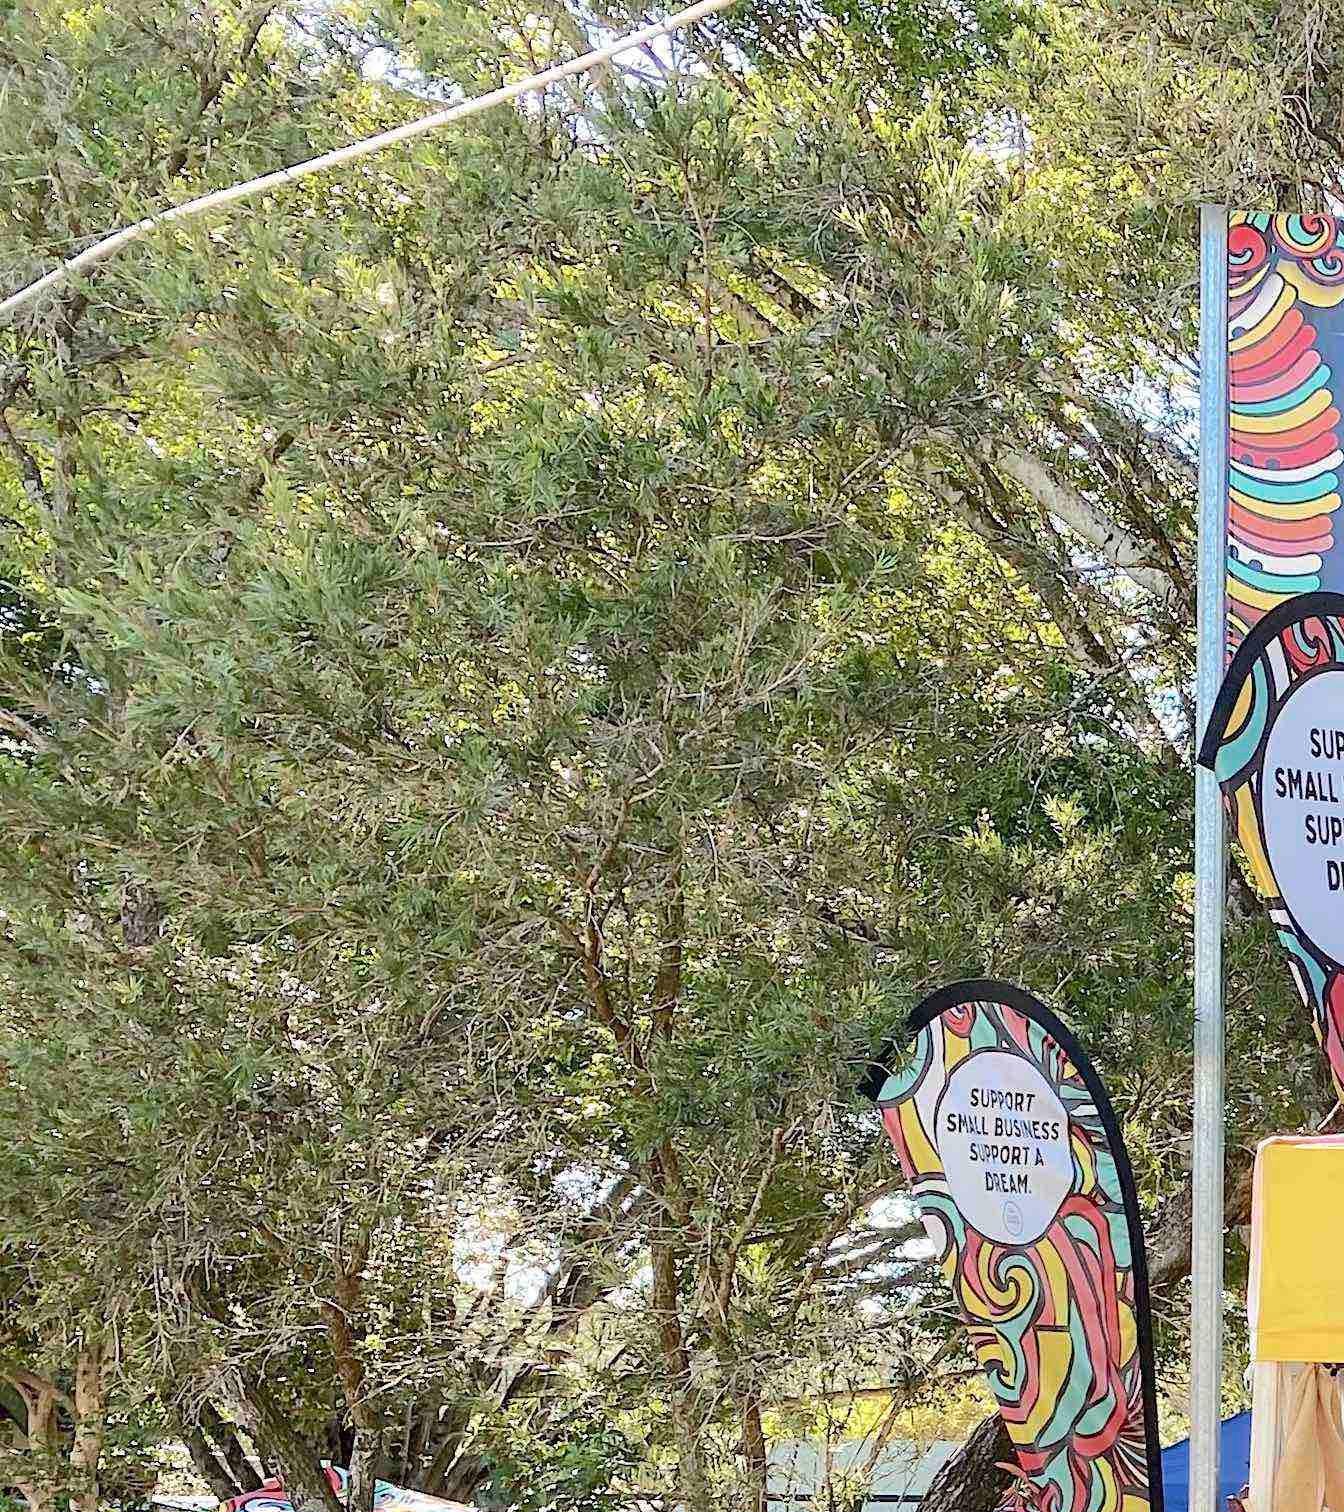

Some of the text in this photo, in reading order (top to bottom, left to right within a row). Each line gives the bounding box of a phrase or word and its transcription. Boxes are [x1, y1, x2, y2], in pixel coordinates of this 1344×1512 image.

[1275, 767, 1339, 803] SMALL
[970, 1088, 1036, 1112] SUPPORT
[946, 1114, 1060, 1141] SMALL BUSINESS
[969, 1143, 1045, 1167] SUPPORT A
[985, 1172, 1032, 1195] DREAM.
